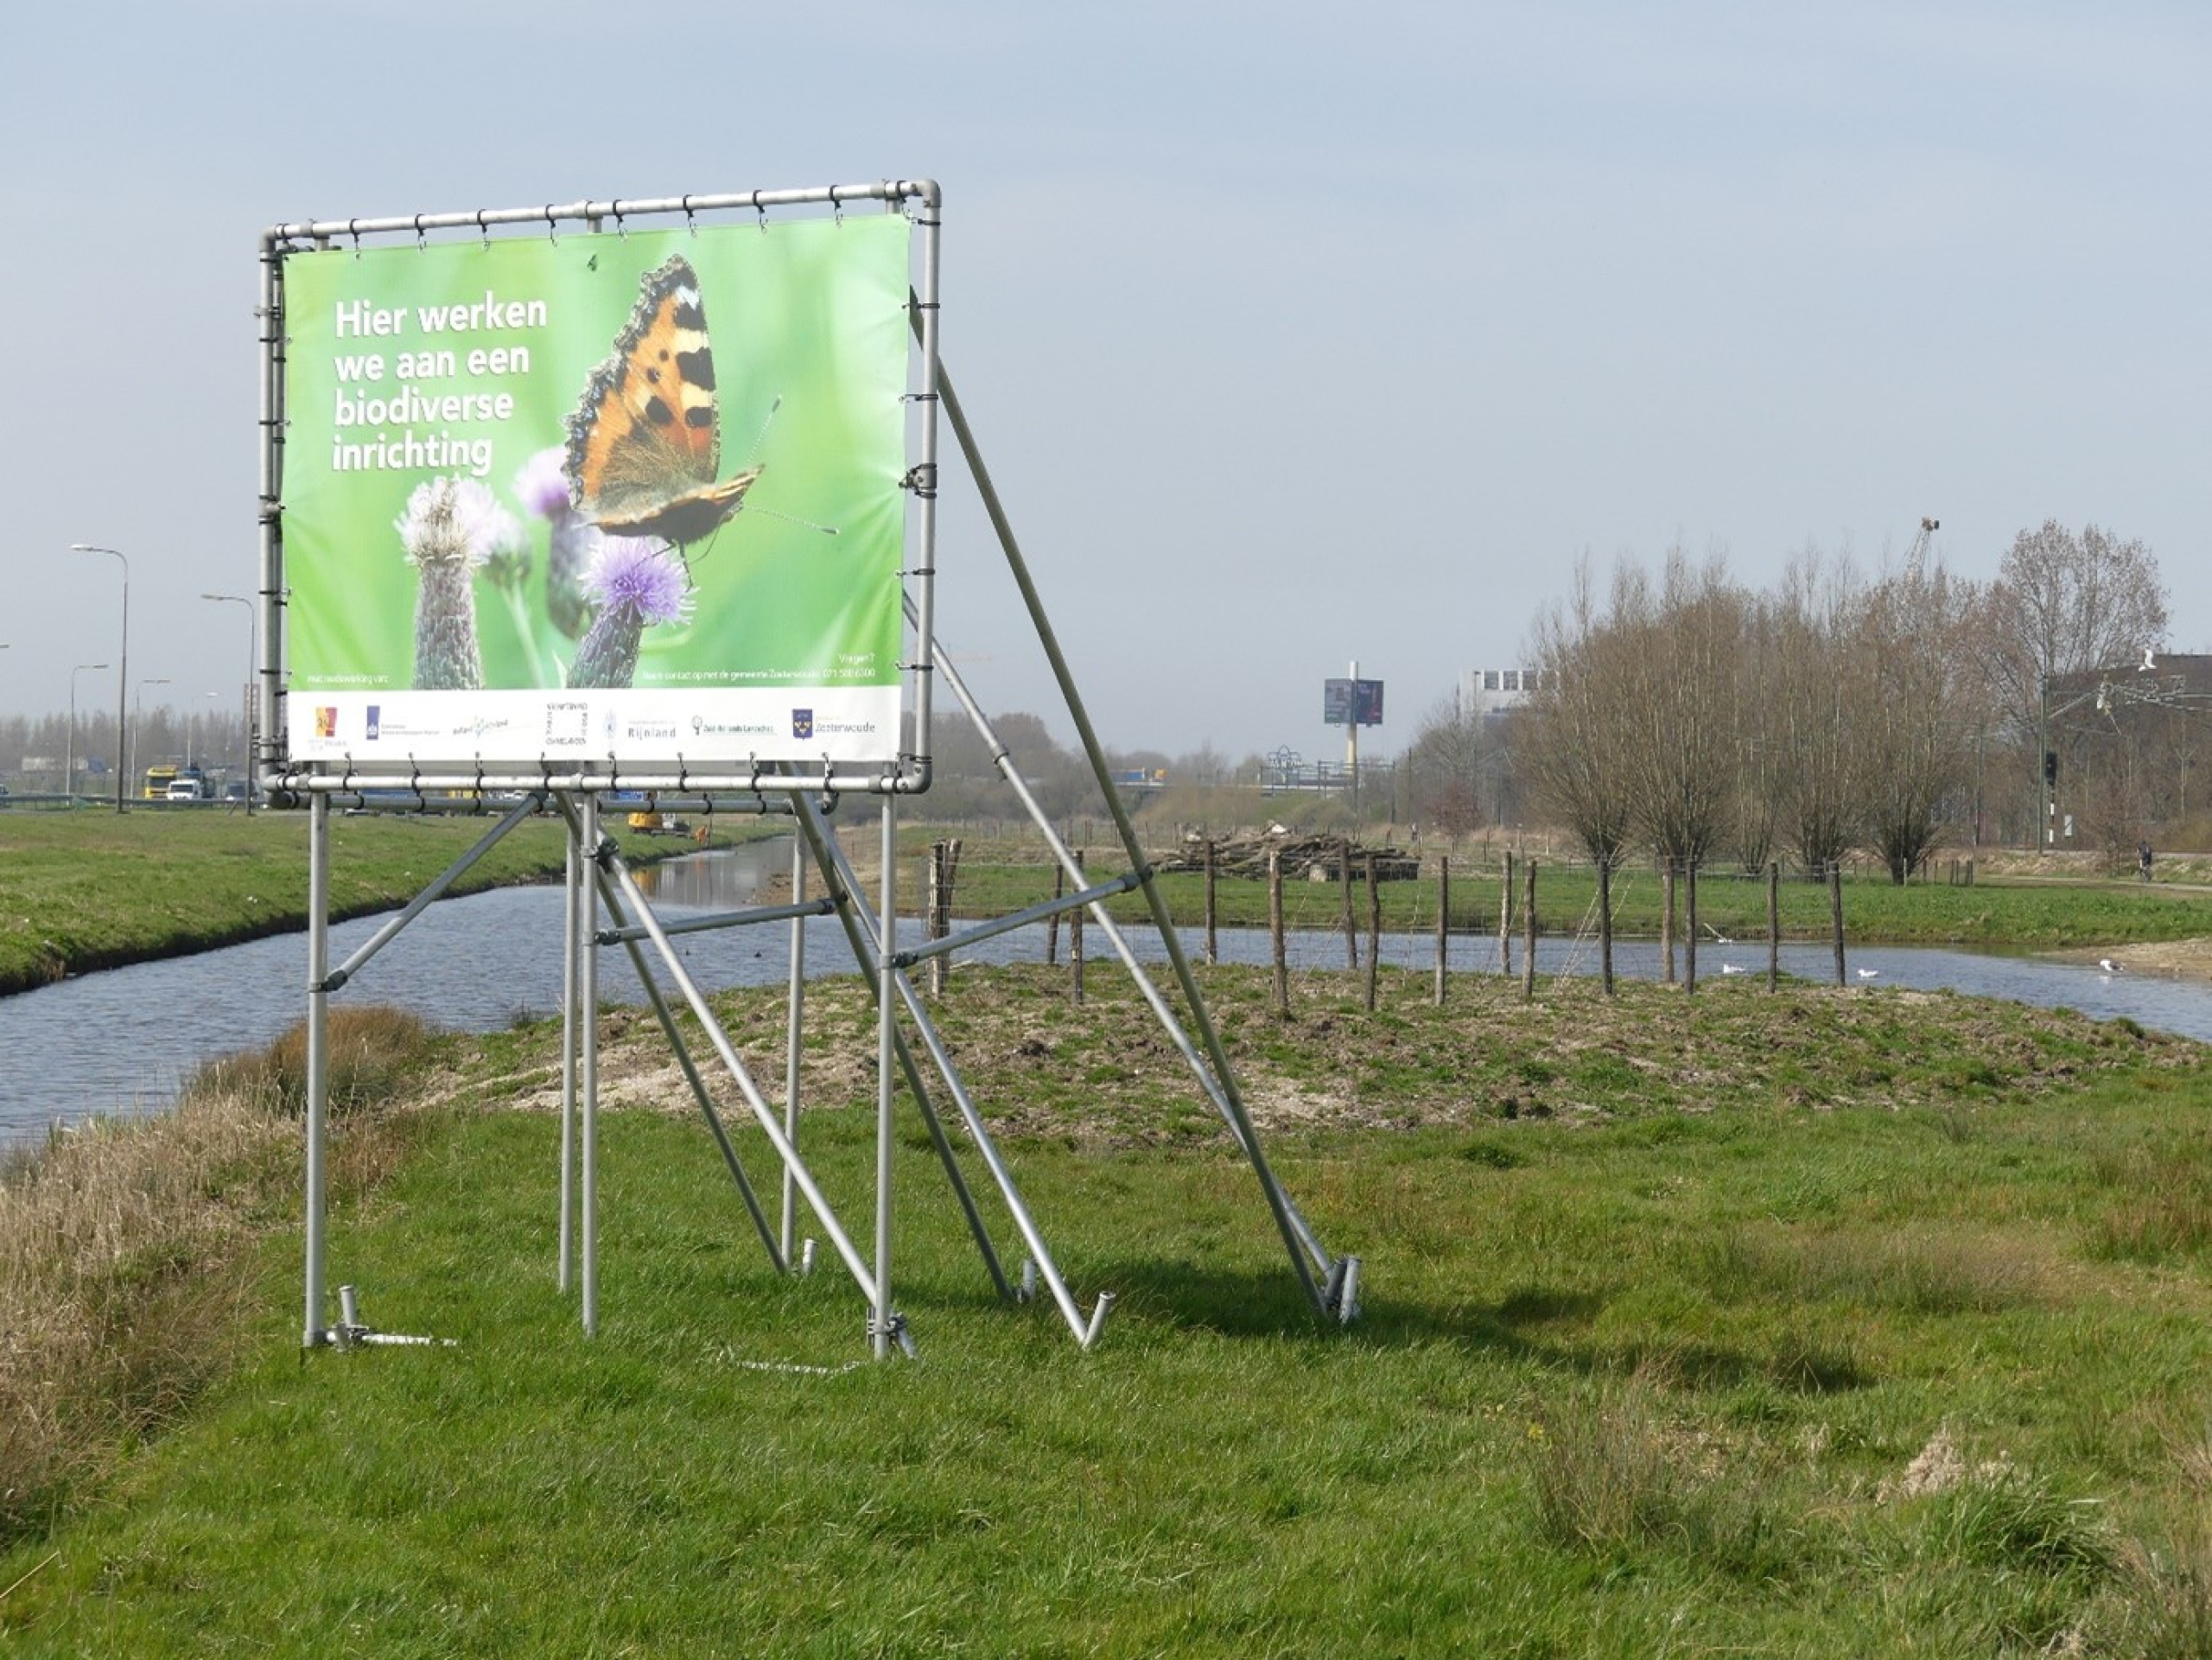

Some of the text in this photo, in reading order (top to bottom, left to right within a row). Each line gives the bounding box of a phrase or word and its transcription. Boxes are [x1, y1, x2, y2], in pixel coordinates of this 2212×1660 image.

[335, 290, 547, 338] Hier werken
[334, 347, 530, 382] we aan een
[334, 385, 514, 426] biodiverse
[333, 429, 493, 476] inrichting
[628, 727, 676, 741] Rijnland
